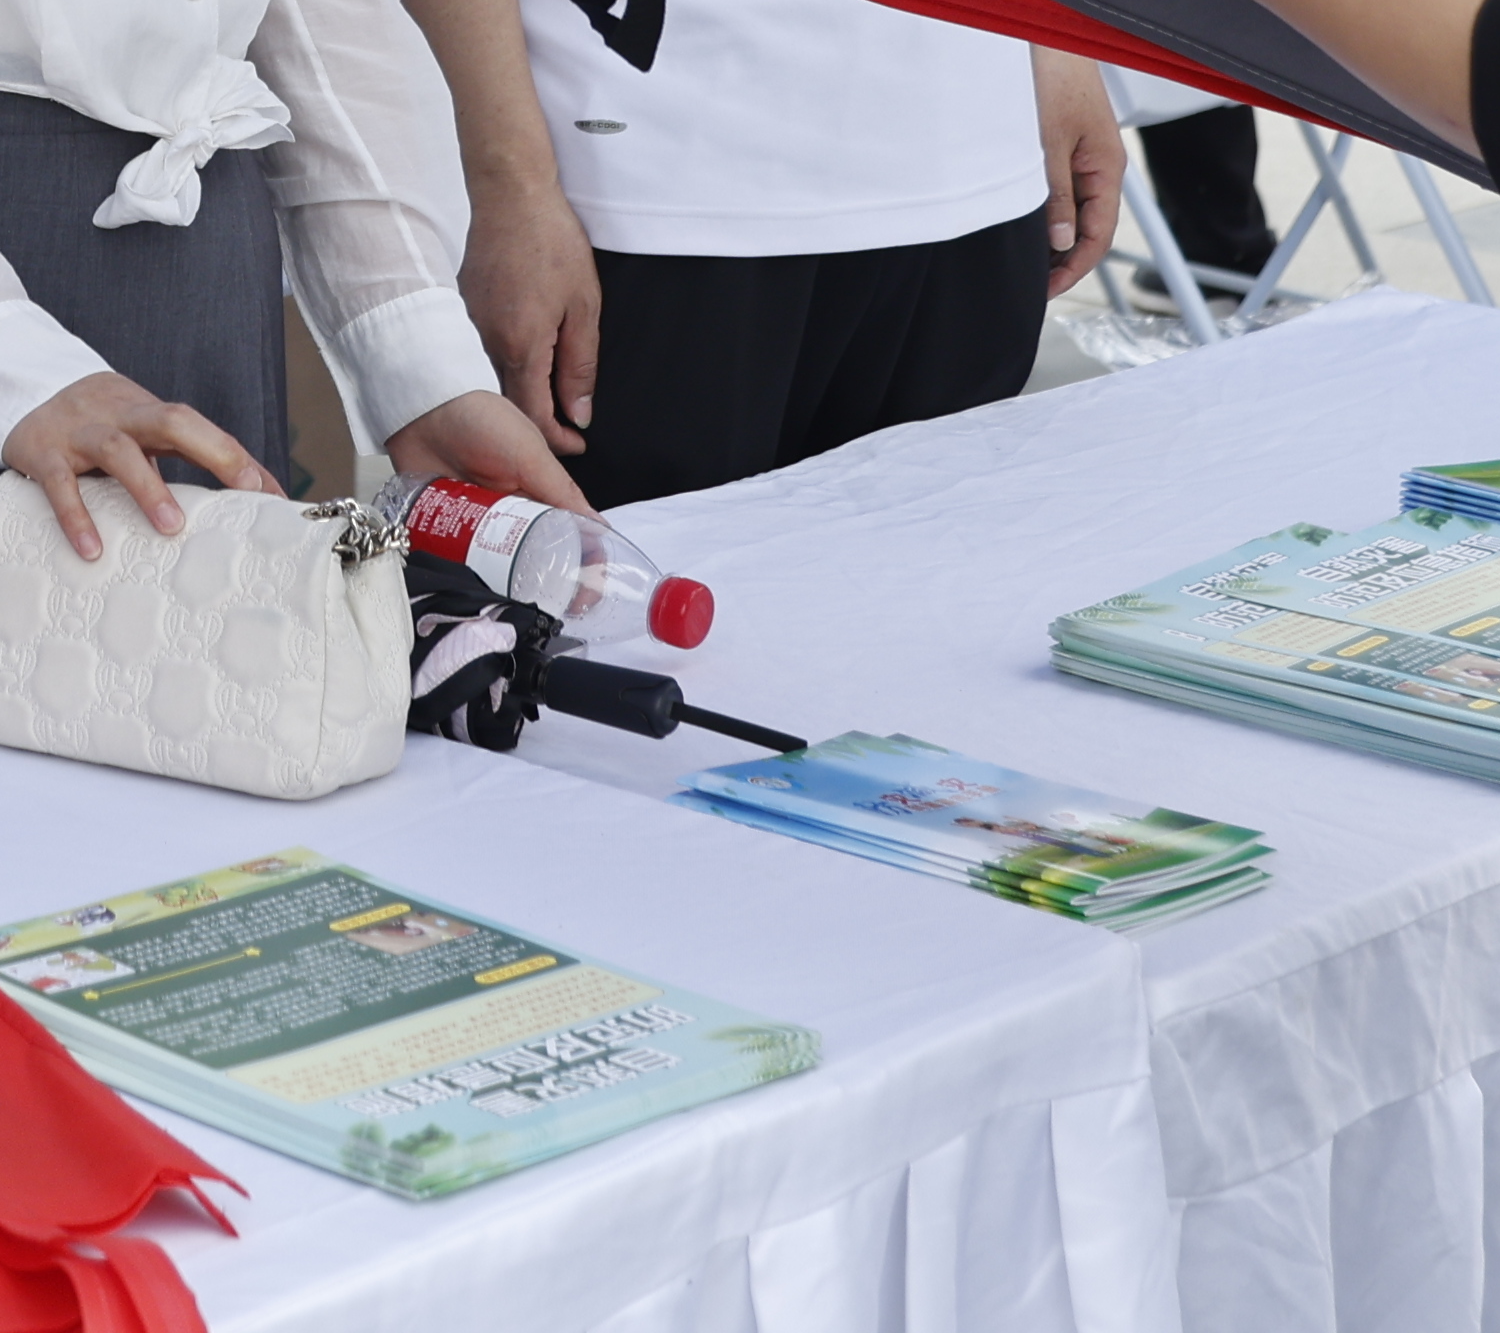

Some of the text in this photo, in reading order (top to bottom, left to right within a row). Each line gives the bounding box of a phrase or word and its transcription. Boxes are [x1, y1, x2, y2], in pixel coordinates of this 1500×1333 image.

[1297, 535, 1427, 582] 自然灾害
[336, 1003, 698, 1122] 防范及应急措施
[466, 1047, 682, 1119] 自然灾害
